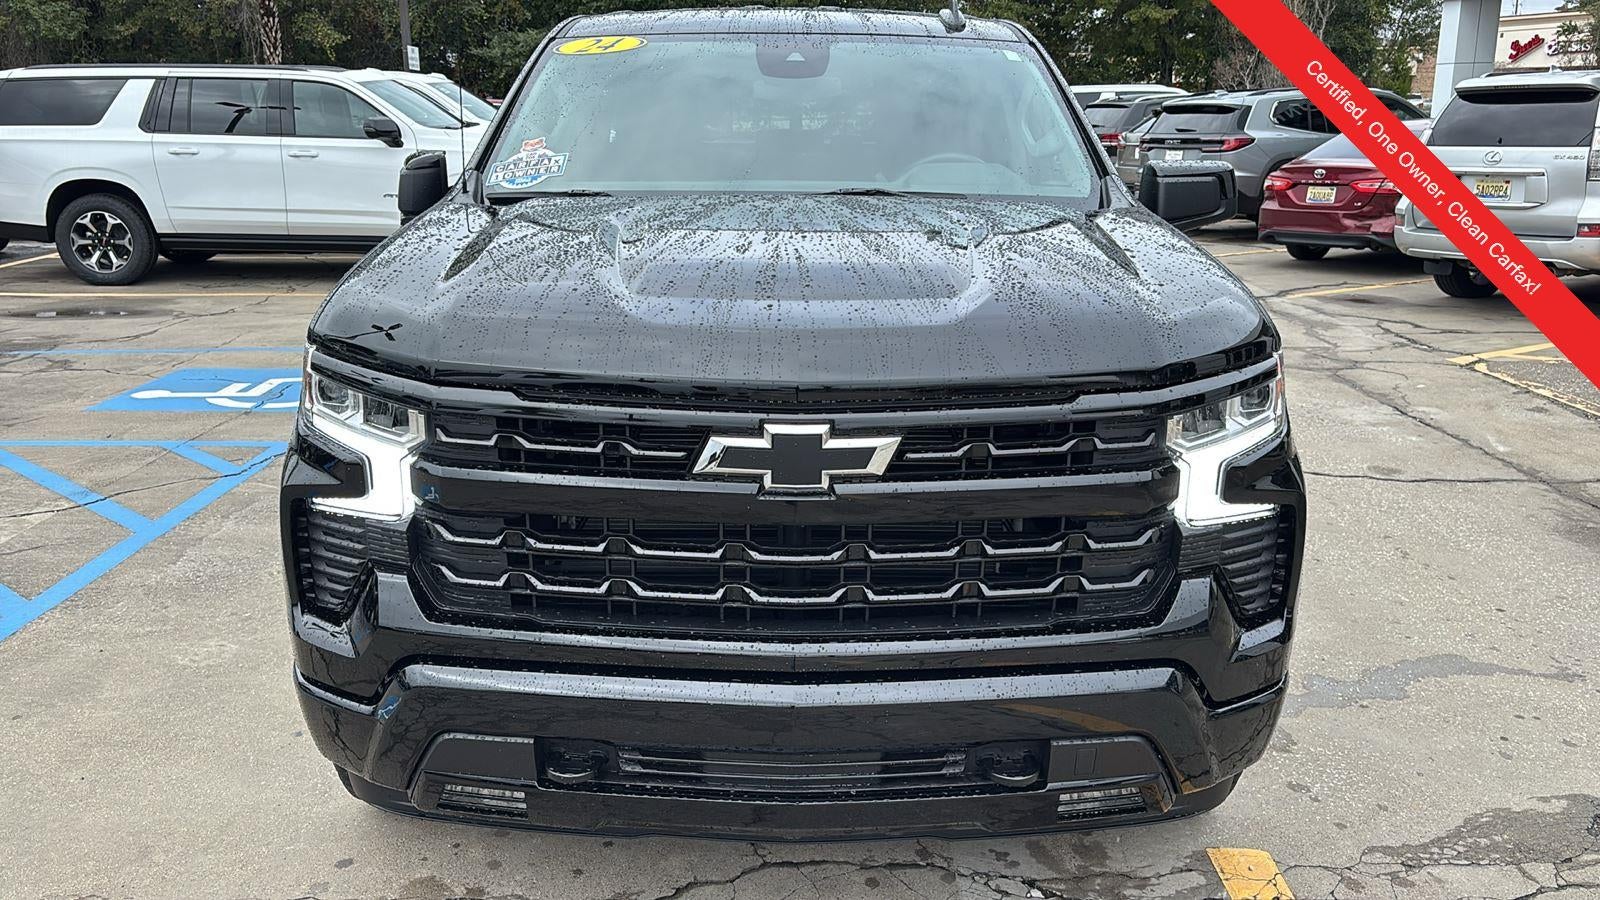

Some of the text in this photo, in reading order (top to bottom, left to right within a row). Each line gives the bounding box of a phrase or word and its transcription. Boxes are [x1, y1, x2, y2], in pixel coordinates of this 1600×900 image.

[574, 38, 625, 52] 24
[495, 157, 562, 173] CARFAX
[503, 163, 561, 179] OWNER
